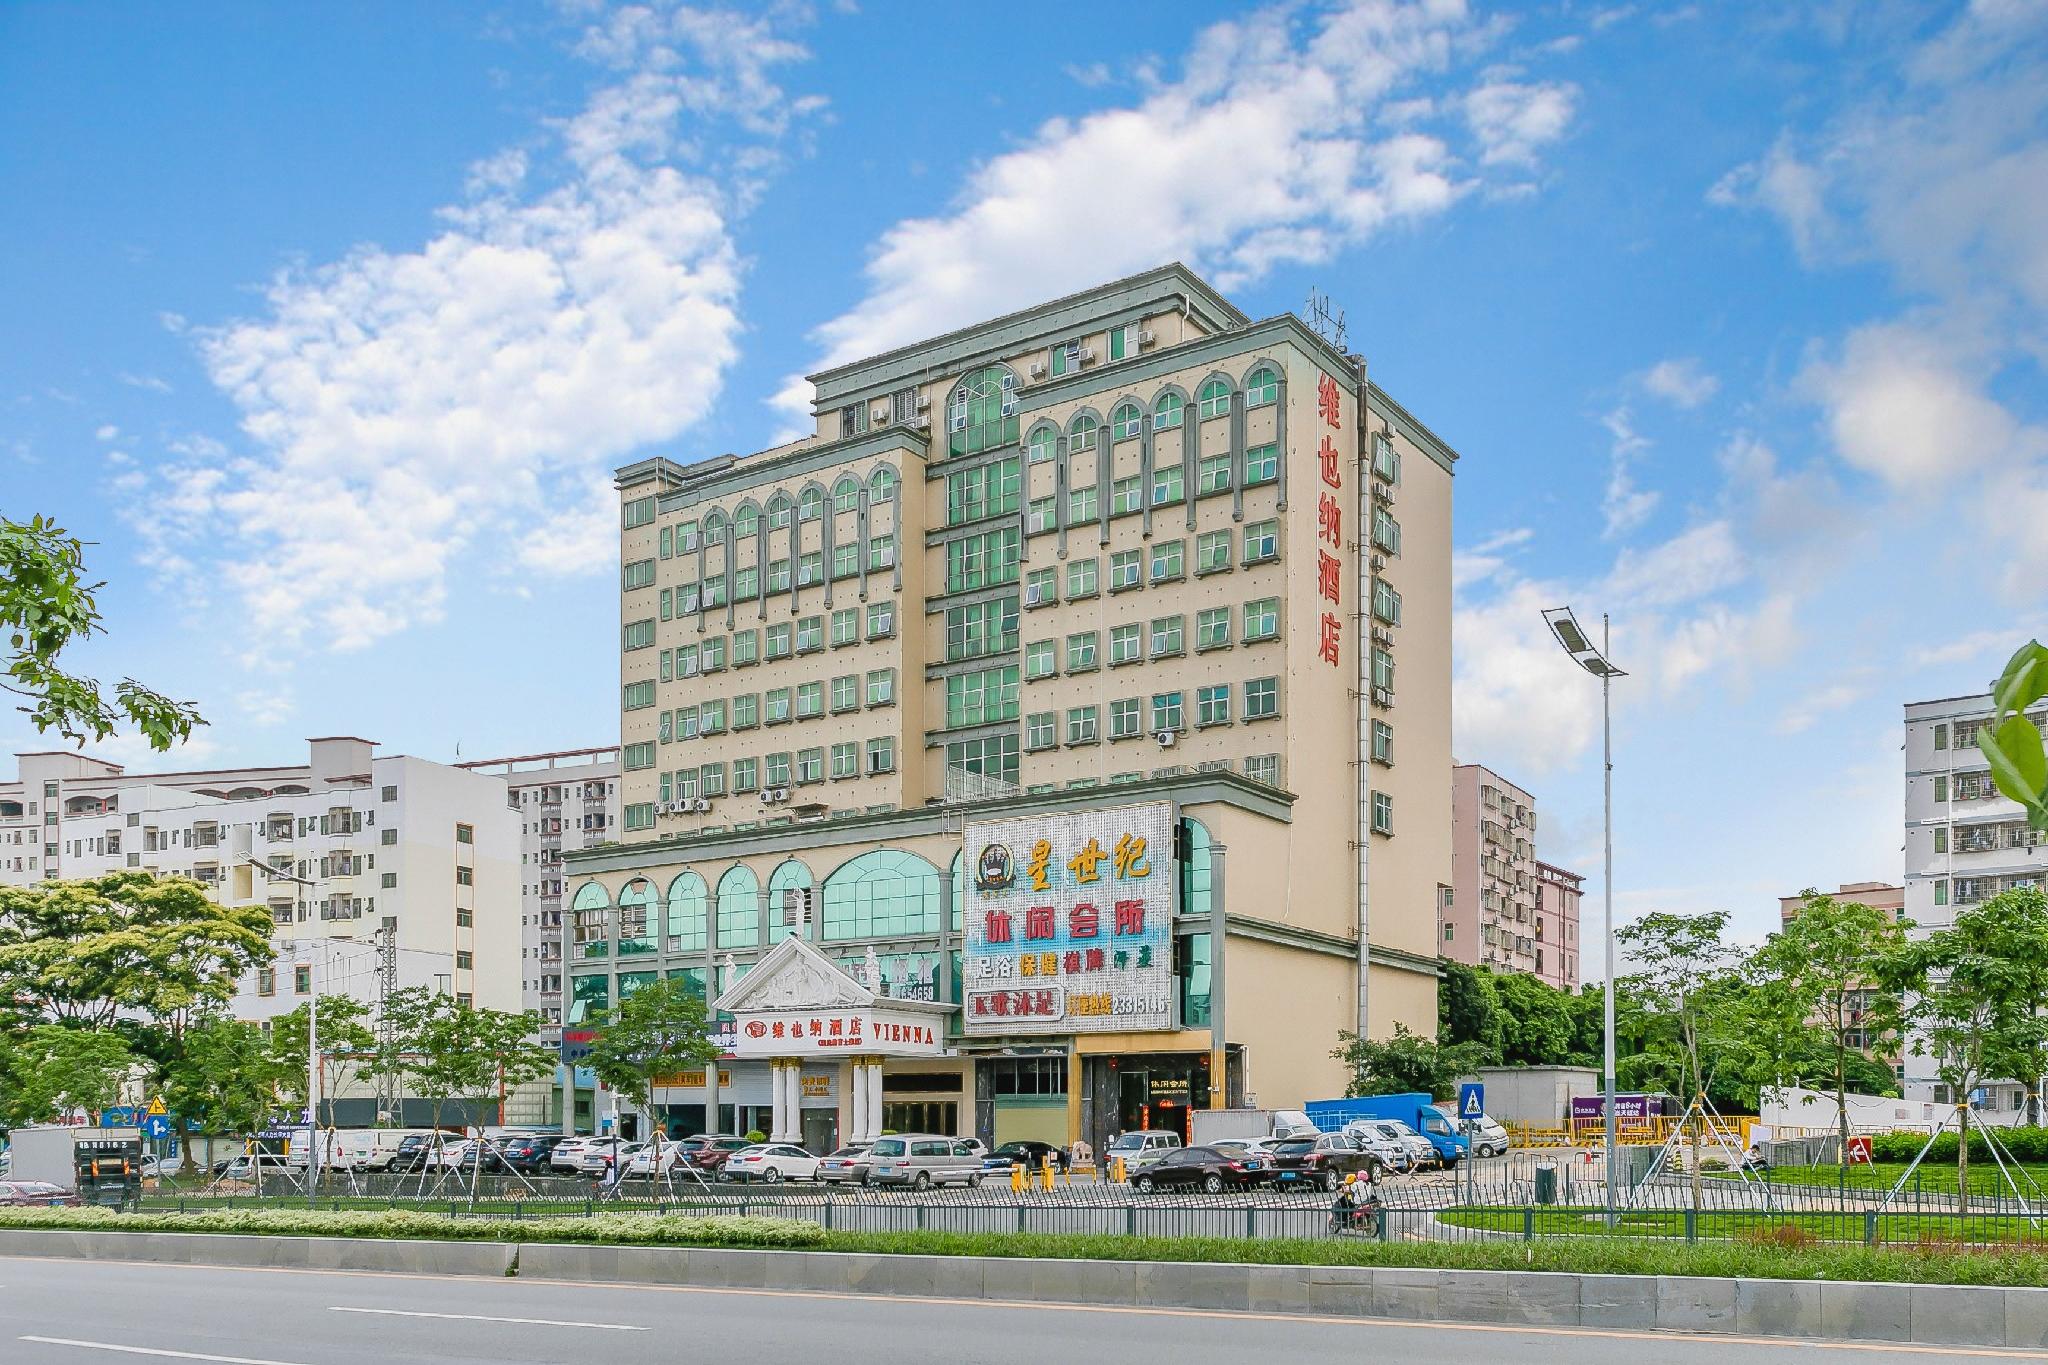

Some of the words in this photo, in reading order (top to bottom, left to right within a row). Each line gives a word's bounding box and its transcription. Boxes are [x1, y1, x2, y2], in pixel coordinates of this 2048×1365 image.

[1317, 372, 1342, 667] 维也纳酒店
[985, 899, 1145, 943] 休闲会所
[771, 1016, 863, 1039] 维也纳酒店
[872, 1022, 934, 1045] VIENNA
[1150, 1080, 1188, 1088] 休闲会所
